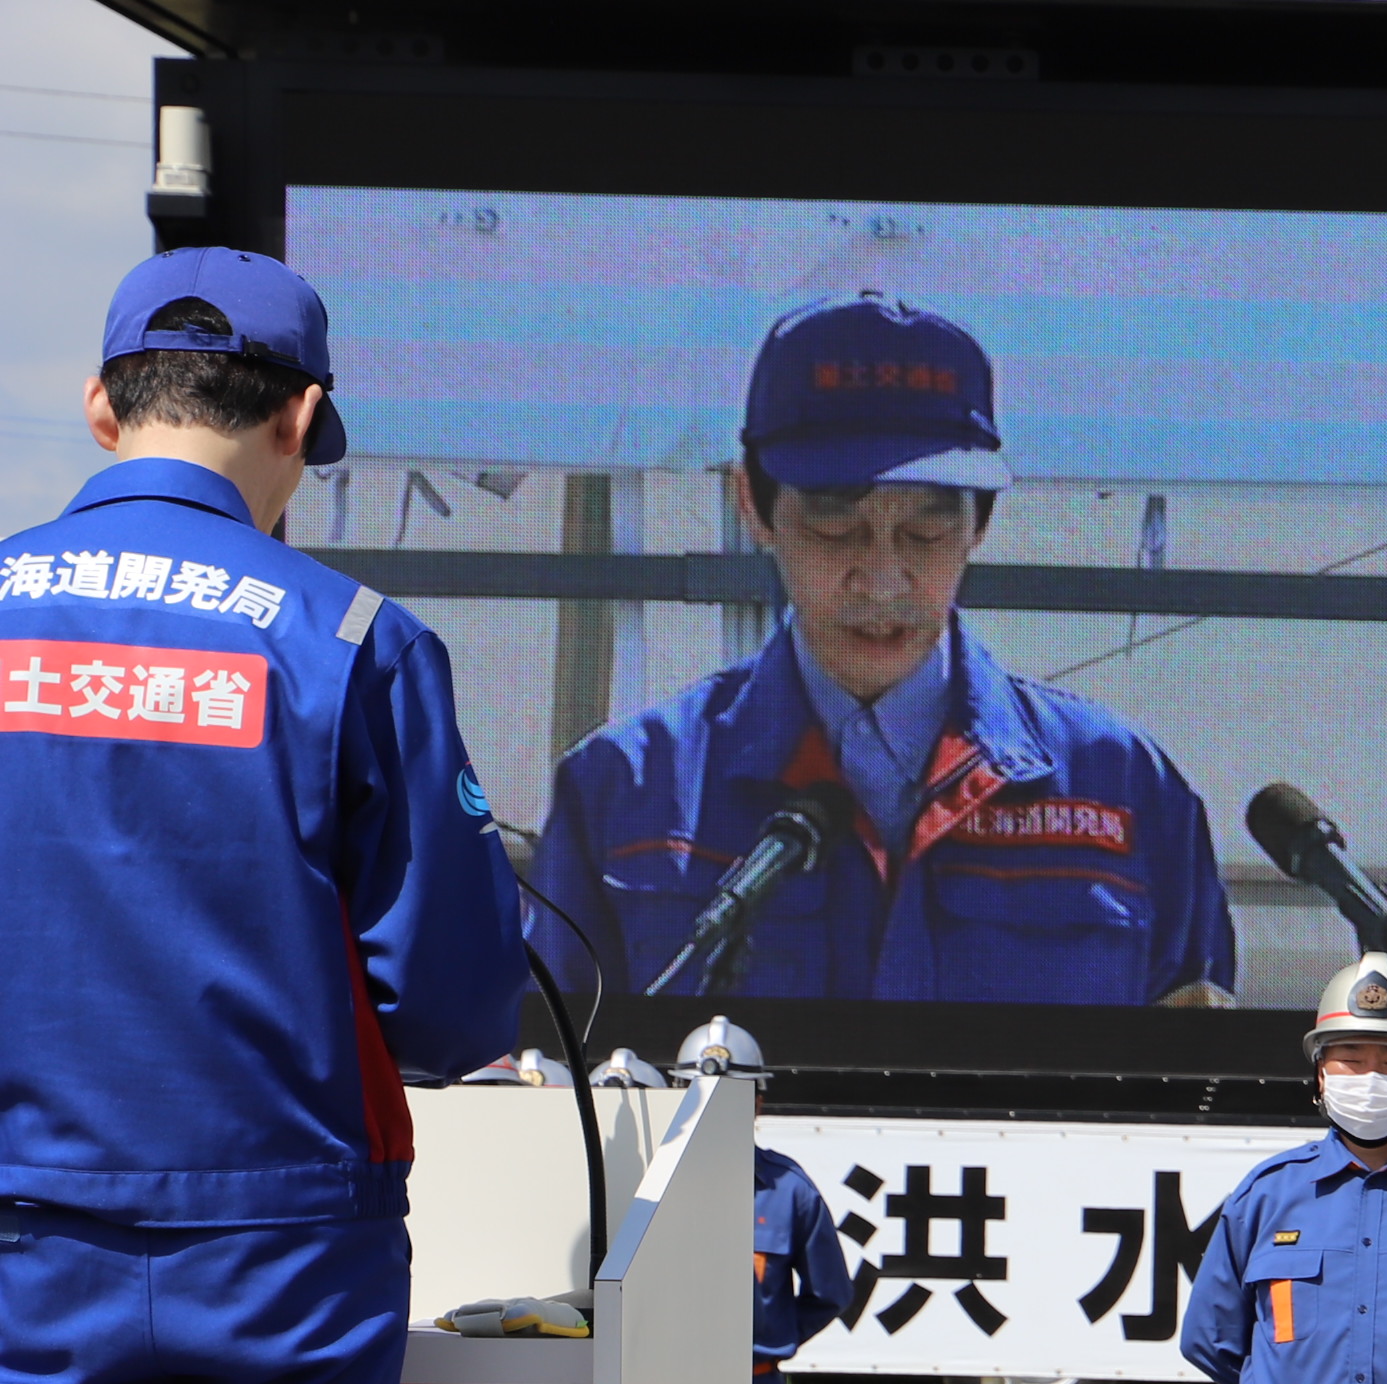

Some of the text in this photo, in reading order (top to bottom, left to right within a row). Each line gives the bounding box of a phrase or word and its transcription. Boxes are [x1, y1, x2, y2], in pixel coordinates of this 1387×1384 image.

[0, 550, 287, 629] 海道開発局
[4, 656, 251, 729] 土交通省
